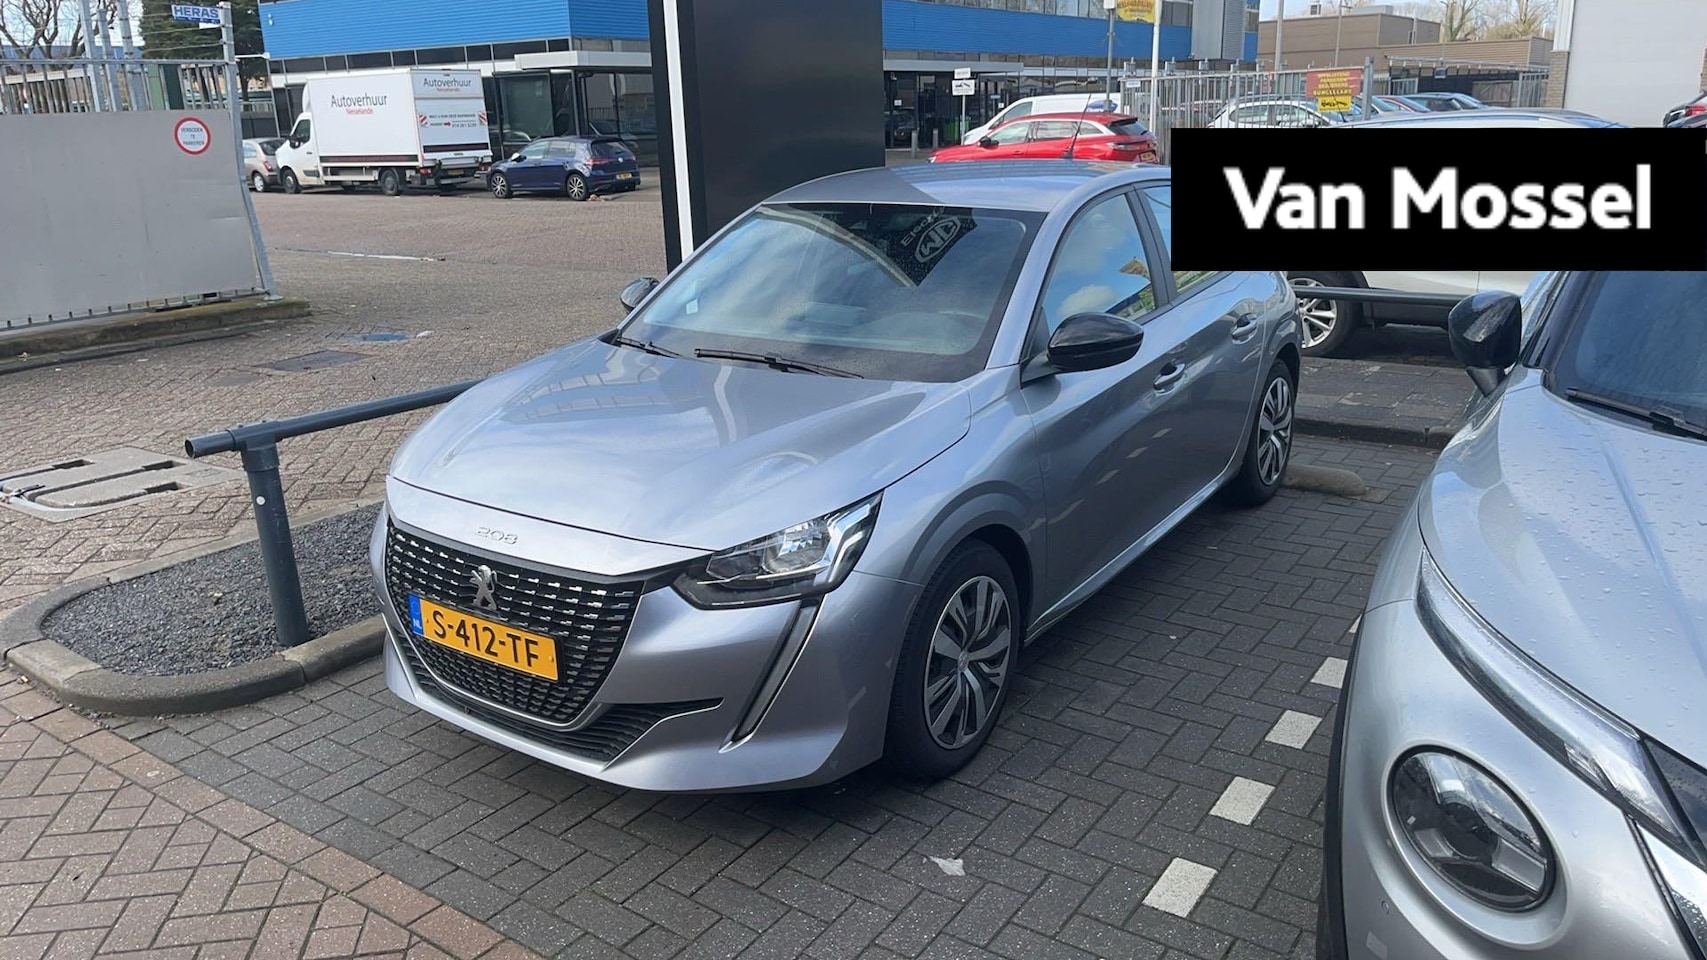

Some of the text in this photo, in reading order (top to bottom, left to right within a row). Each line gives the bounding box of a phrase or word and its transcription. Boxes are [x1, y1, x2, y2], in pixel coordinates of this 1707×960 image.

[174, 6, 219, 18] HERAS
[423, 77, 471, 87] Autoverhuur
[331, 92, 387, 108] Autoverhuur
[475, 527, 519, 545] 208
[412, 610, 539, 668] NL S-412-TF
